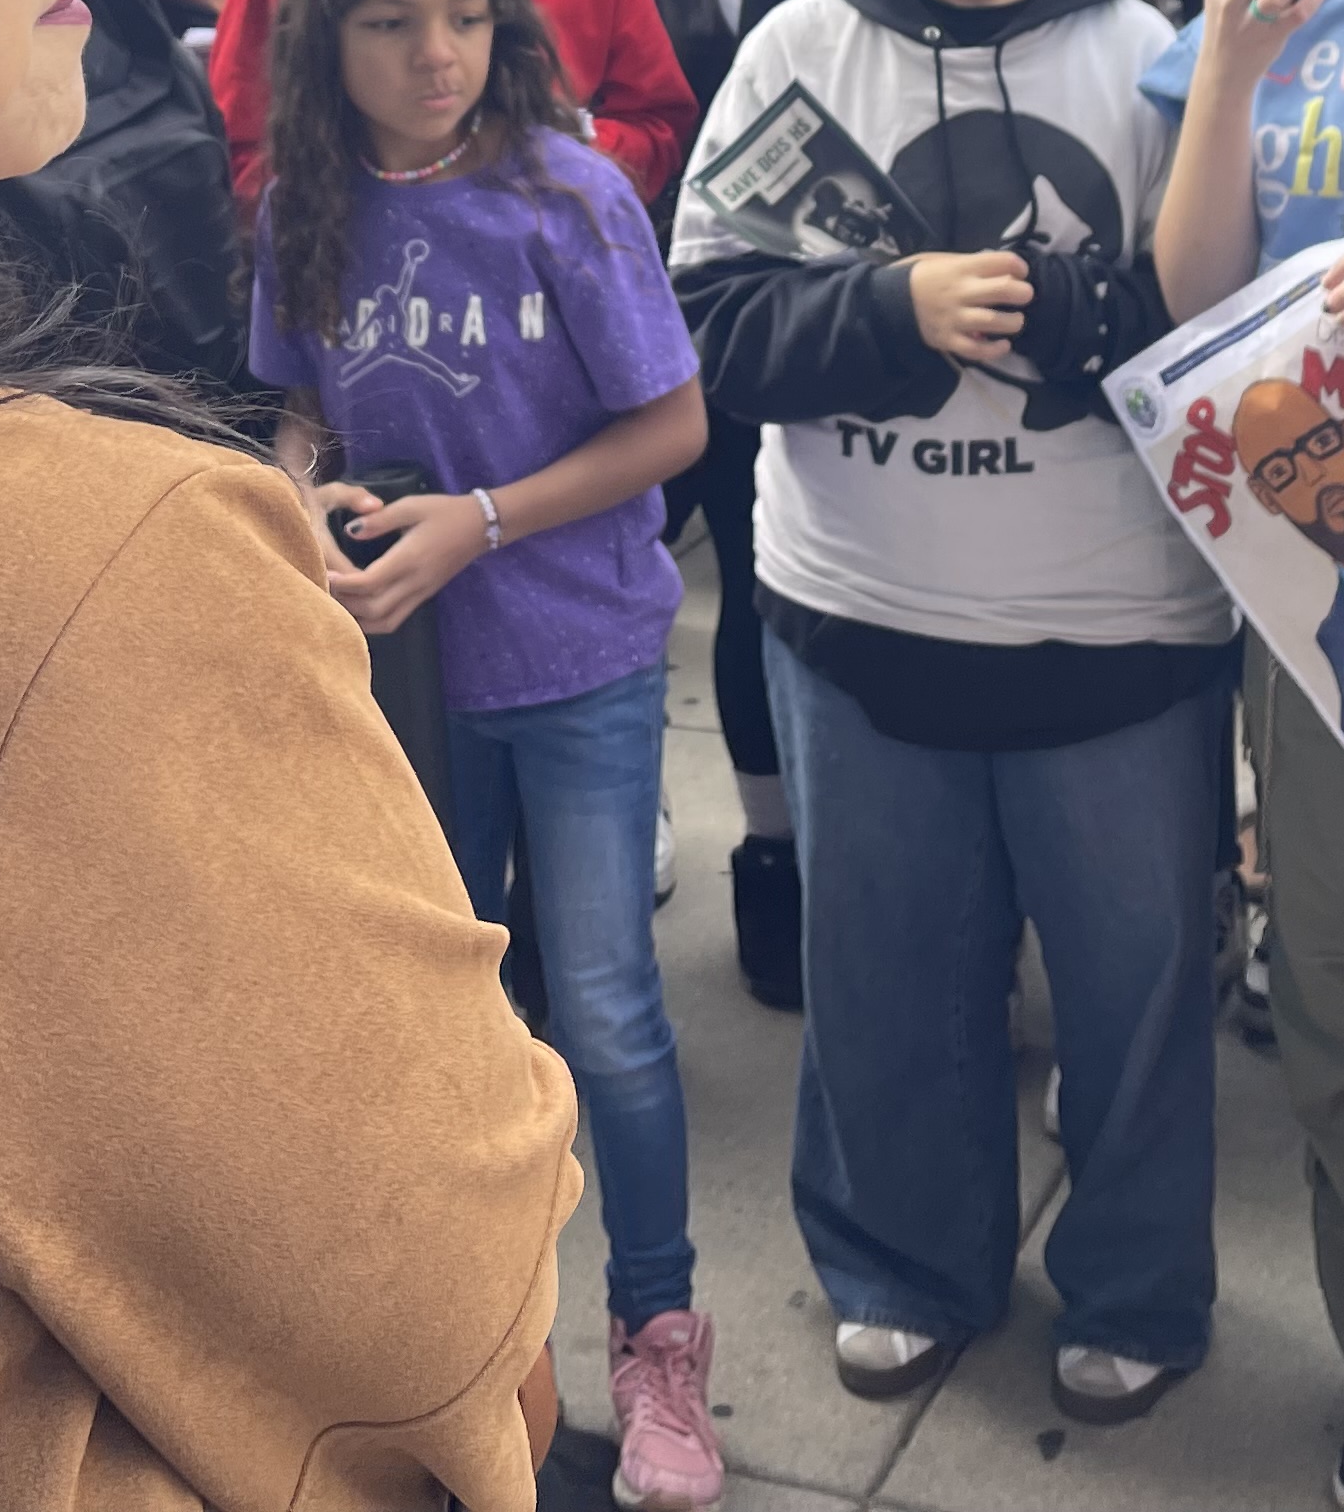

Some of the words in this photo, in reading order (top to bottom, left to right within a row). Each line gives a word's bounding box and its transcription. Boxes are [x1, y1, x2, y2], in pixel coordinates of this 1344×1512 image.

[722, 166, 761, 202] SAVE
[835, 419, 899, 467] TV
[913, 437, 1035, 476] GIRL
[1167, 396, 1237, 539] STOP
